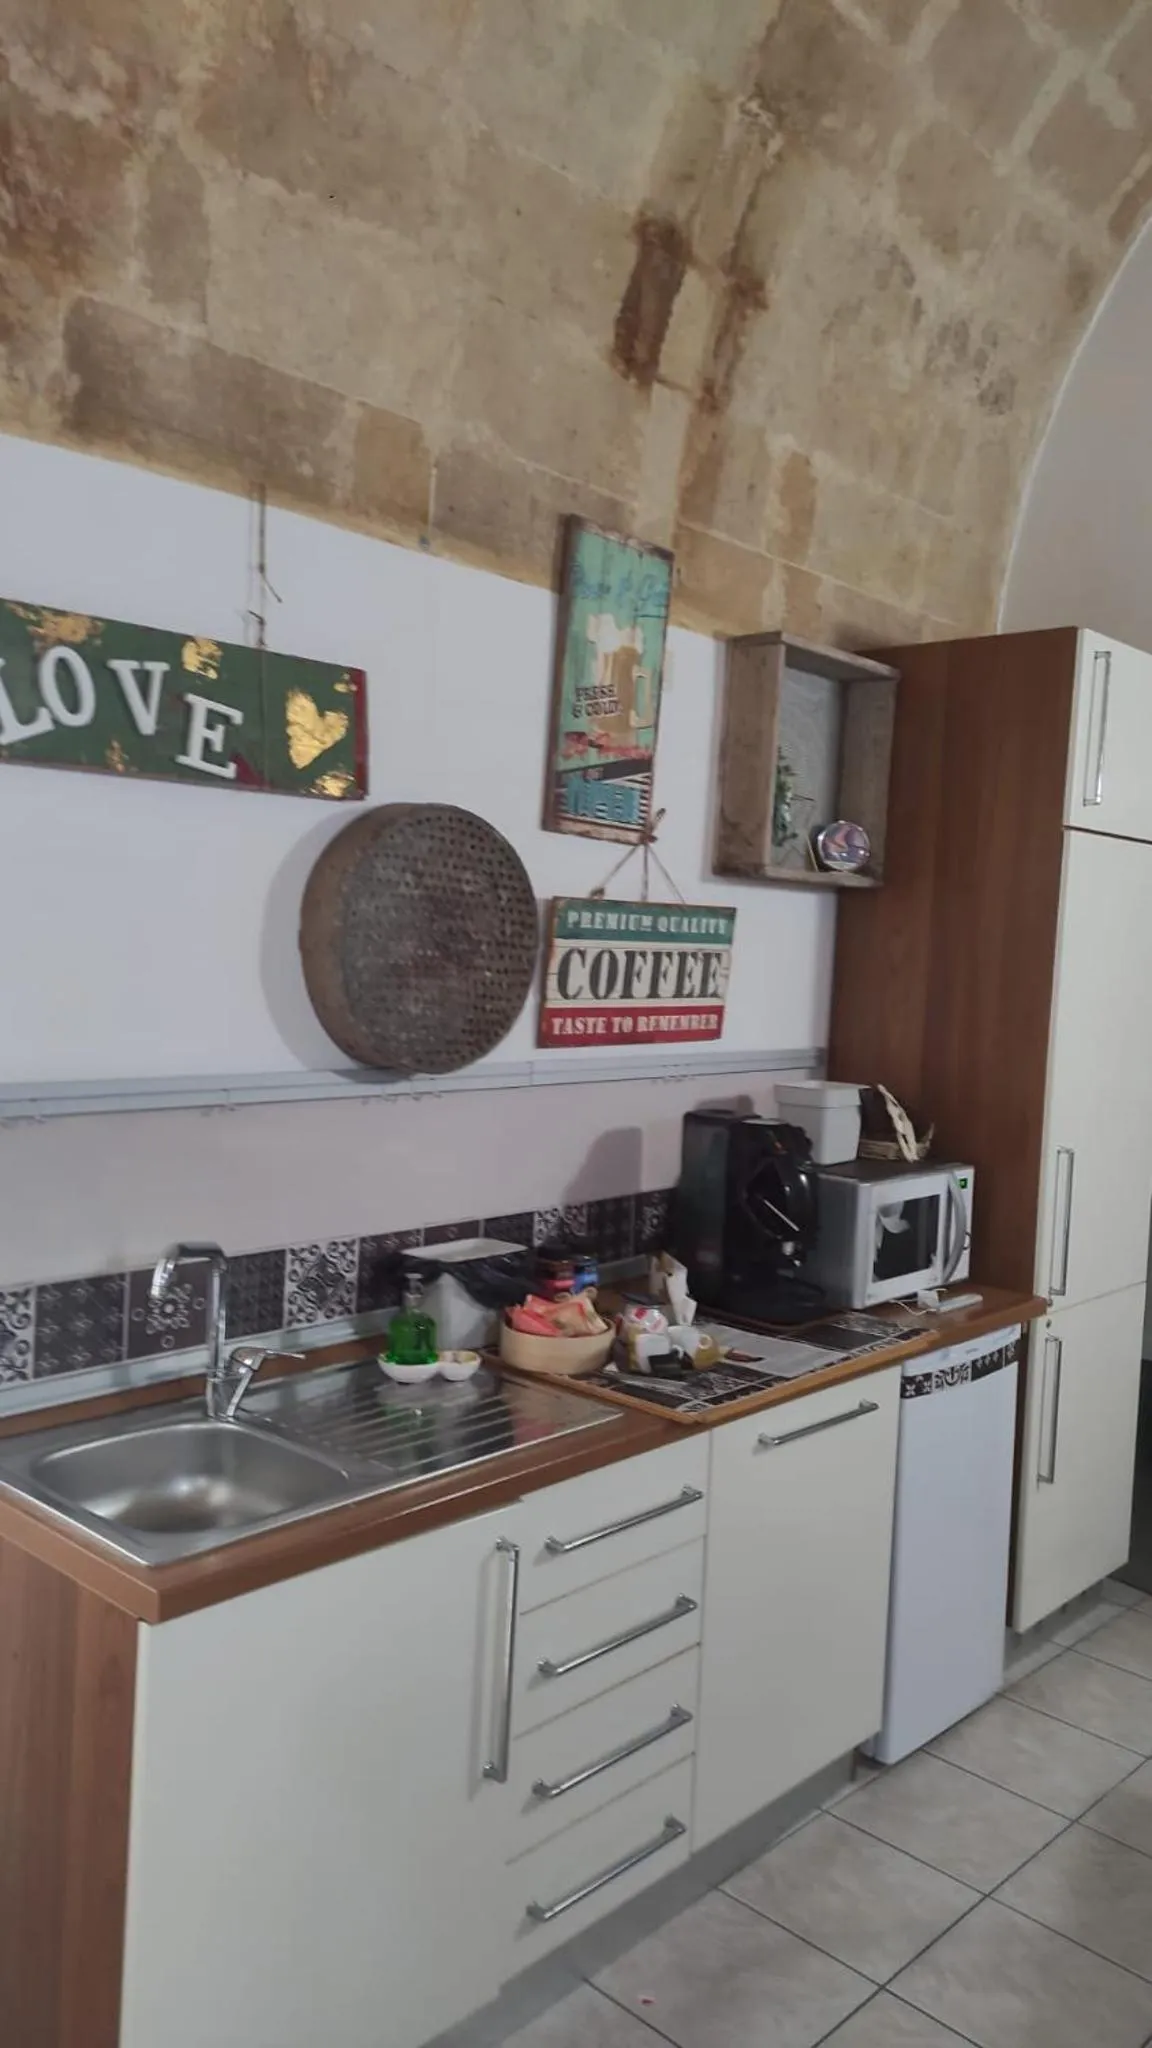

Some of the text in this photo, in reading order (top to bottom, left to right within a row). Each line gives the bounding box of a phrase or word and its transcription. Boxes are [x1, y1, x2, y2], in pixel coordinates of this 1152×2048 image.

[0, 645, 244, 779] LOVE
[567, 910, 728, 934] PREMIUM QUALITY
[557, 948, 723, 1000] COFFEE
[552, 1014, 719, 1035] TASTE TO REMEMBER
